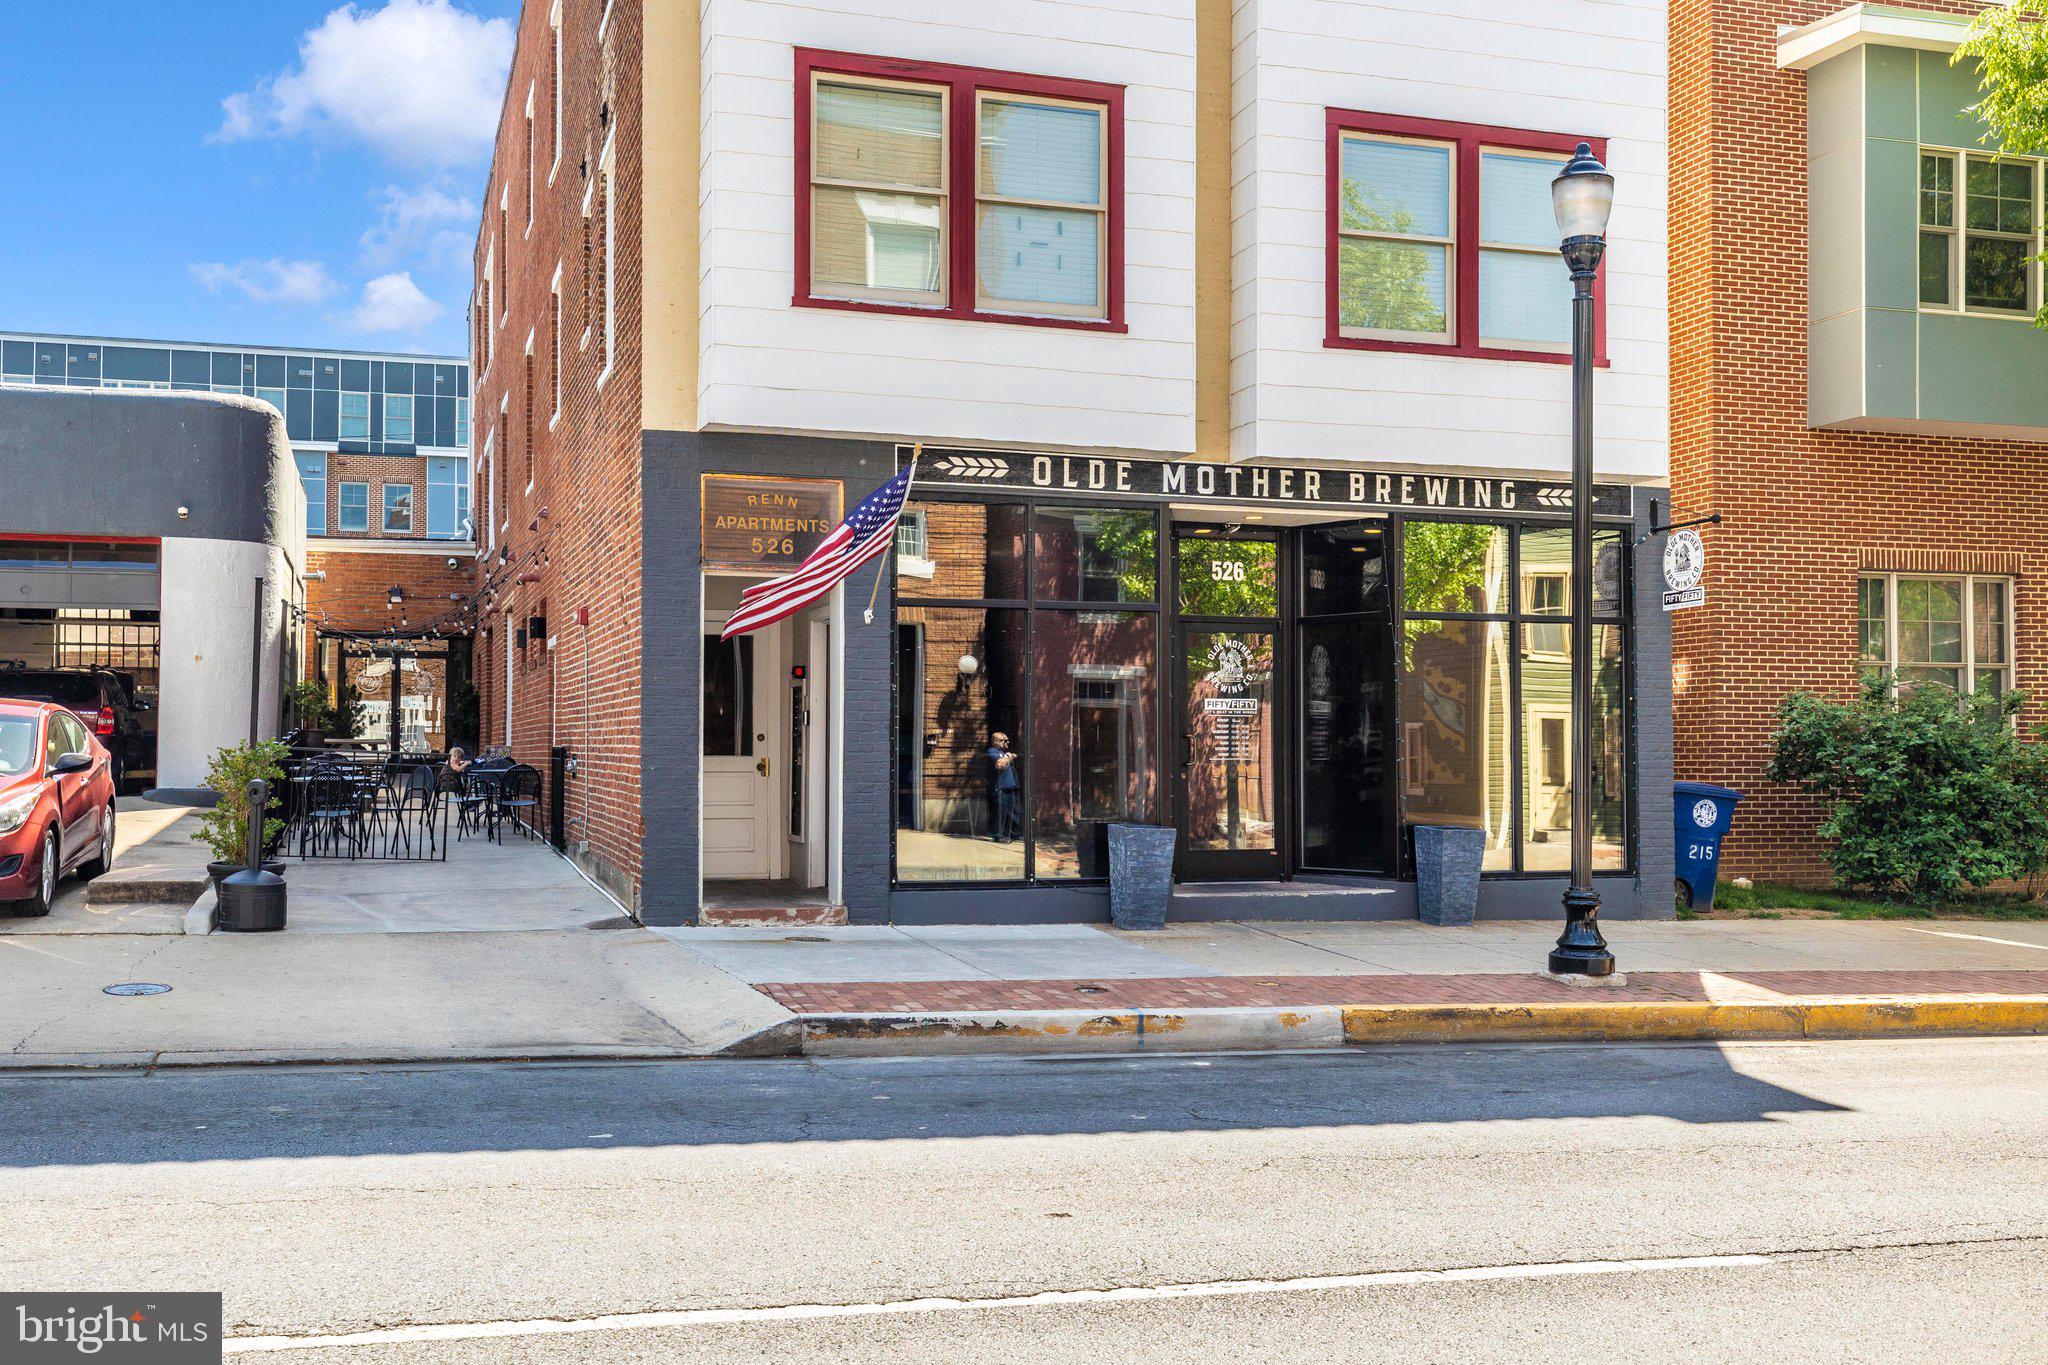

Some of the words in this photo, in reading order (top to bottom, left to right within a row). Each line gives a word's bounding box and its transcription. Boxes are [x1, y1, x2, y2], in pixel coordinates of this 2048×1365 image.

[1032, 456, 1132, 491] OLDE
[1162, 464, 1321, 500] MOTHER
[1349, 472, 1516, 509] BREWING
[747, 493, 798, 508] RENN
[715, 515, 830, 534] APARTMENTS
[751, 538, 794, 555] 526
[1666, 538, 1678, 557] OLDE
[1678, 533, 1700, 552] MOTHER
[1211, 560, 1244, 581] 526
[1665, 569, 1692, 589] BREWING
[1207, 642, 1224, 660] OLDE
[1225, 639, 1254, 660] MOTHER
[1206, 671, 1244, 694] BREWING
[1688, 844, 1714, 860] 215
